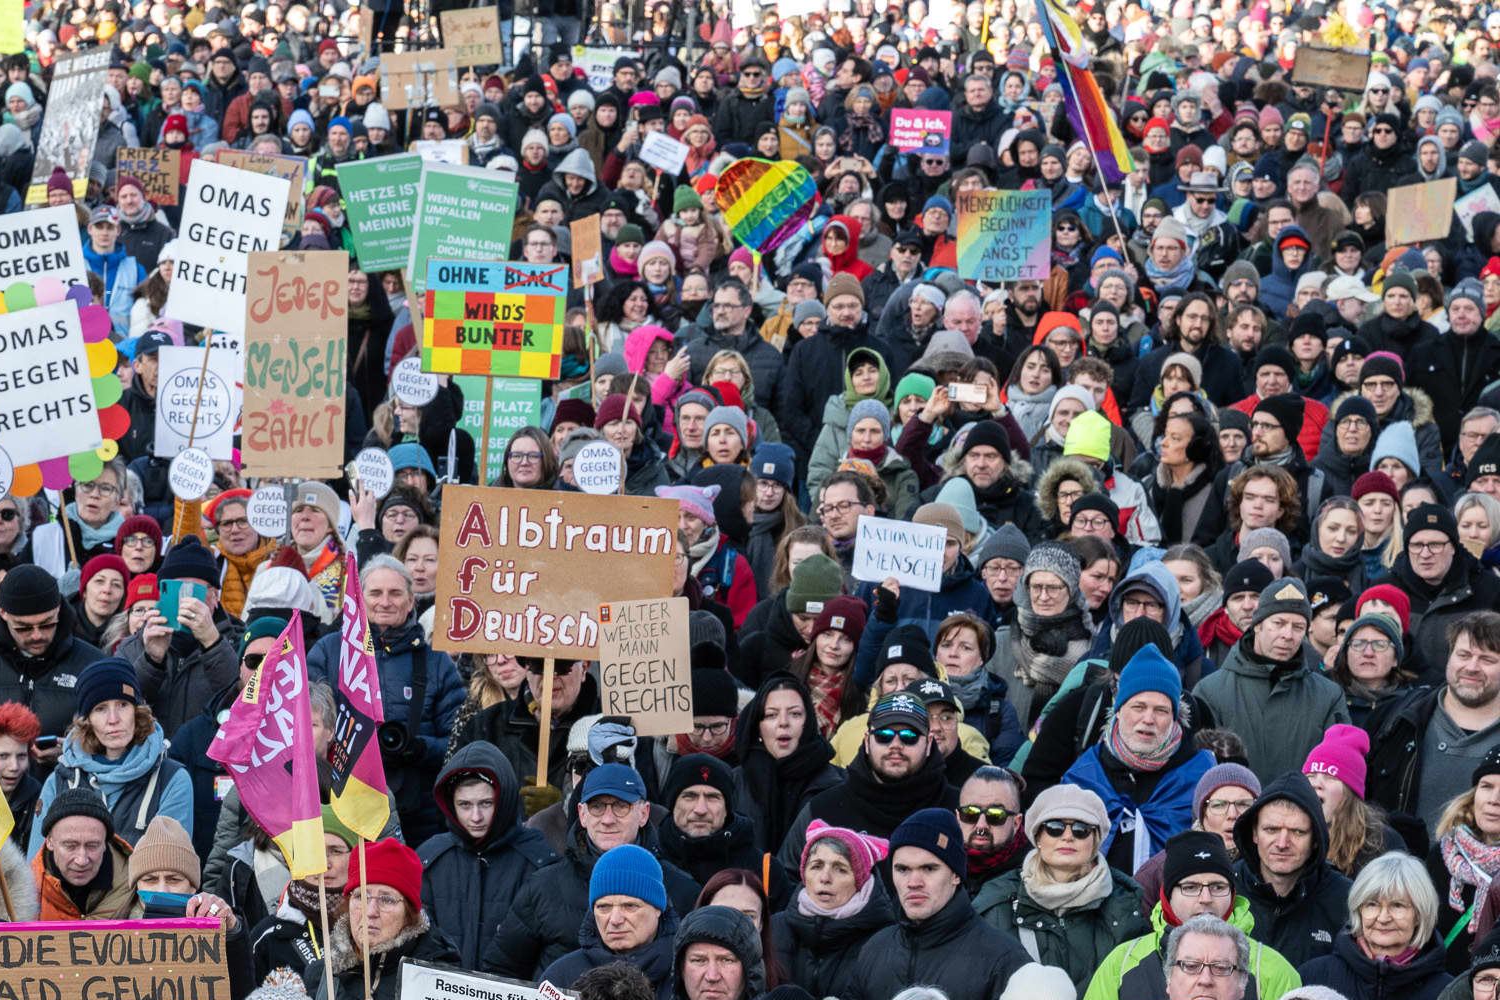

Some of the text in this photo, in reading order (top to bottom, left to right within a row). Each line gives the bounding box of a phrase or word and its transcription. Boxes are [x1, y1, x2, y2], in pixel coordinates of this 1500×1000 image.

[894, 117, 912, 128] Du
[925, 118, 947, 131] ich.
[118, 150, 171, 162] FRITZE
[118, 160, 161, 173] MERZ
[199, 184, 272, 218] OMAS
[349, 182, 421, 203] HETZE IST
[367, 200, 412, 217] KEINE
[427, 193, 510, 214] WENN DIR NACH
[425, 204, 481, 222] UMFALLEN
[980, 216, 1035, 232] BEGINNT
[478, 239, 506, 251] LEHN
[993, 233, 1019, 246] WO
[437, 245, 463, 257] DICH
[982, 245, 1035, 261] ANGST
[438, 266, 490, 286] OHNE
[985, 264, 1038, 279] ENDET
[250, 265, 346, 324] JEDER
[465, 302, 526, 322] WIRD'S
[455, 326, 535, 347] BUNTER
[246, 337, 345, 398] MENSCH
[398, 372, 431, 386] GEGEN
[493, 401, 534, 413] PLATZ
[581, 447, 614, 460] OMAS
[358, 465, 388, 478] GEGEN
[580, 461, 617, 473] GEGEN
[580, 474, 622, 486] RECHTS
[456, 502, 673, 555] Albtraum
[866, 550, 937, 581] MENSCH
[457, 555, 539, 595] für
[616, 602, 671, 624] ALTER
[447, 596, 599, 649] Deutsch
[603, 623, 671, 644] WEISSER
[617, 639, 660, 658] MANN
[603, 658, 676, 688] GEGEN
[609, 684, 691, 715] RECHTS
[1310, 761, 1339, 777] RLG
[68, 931, 222, 966] EVOLUTION
